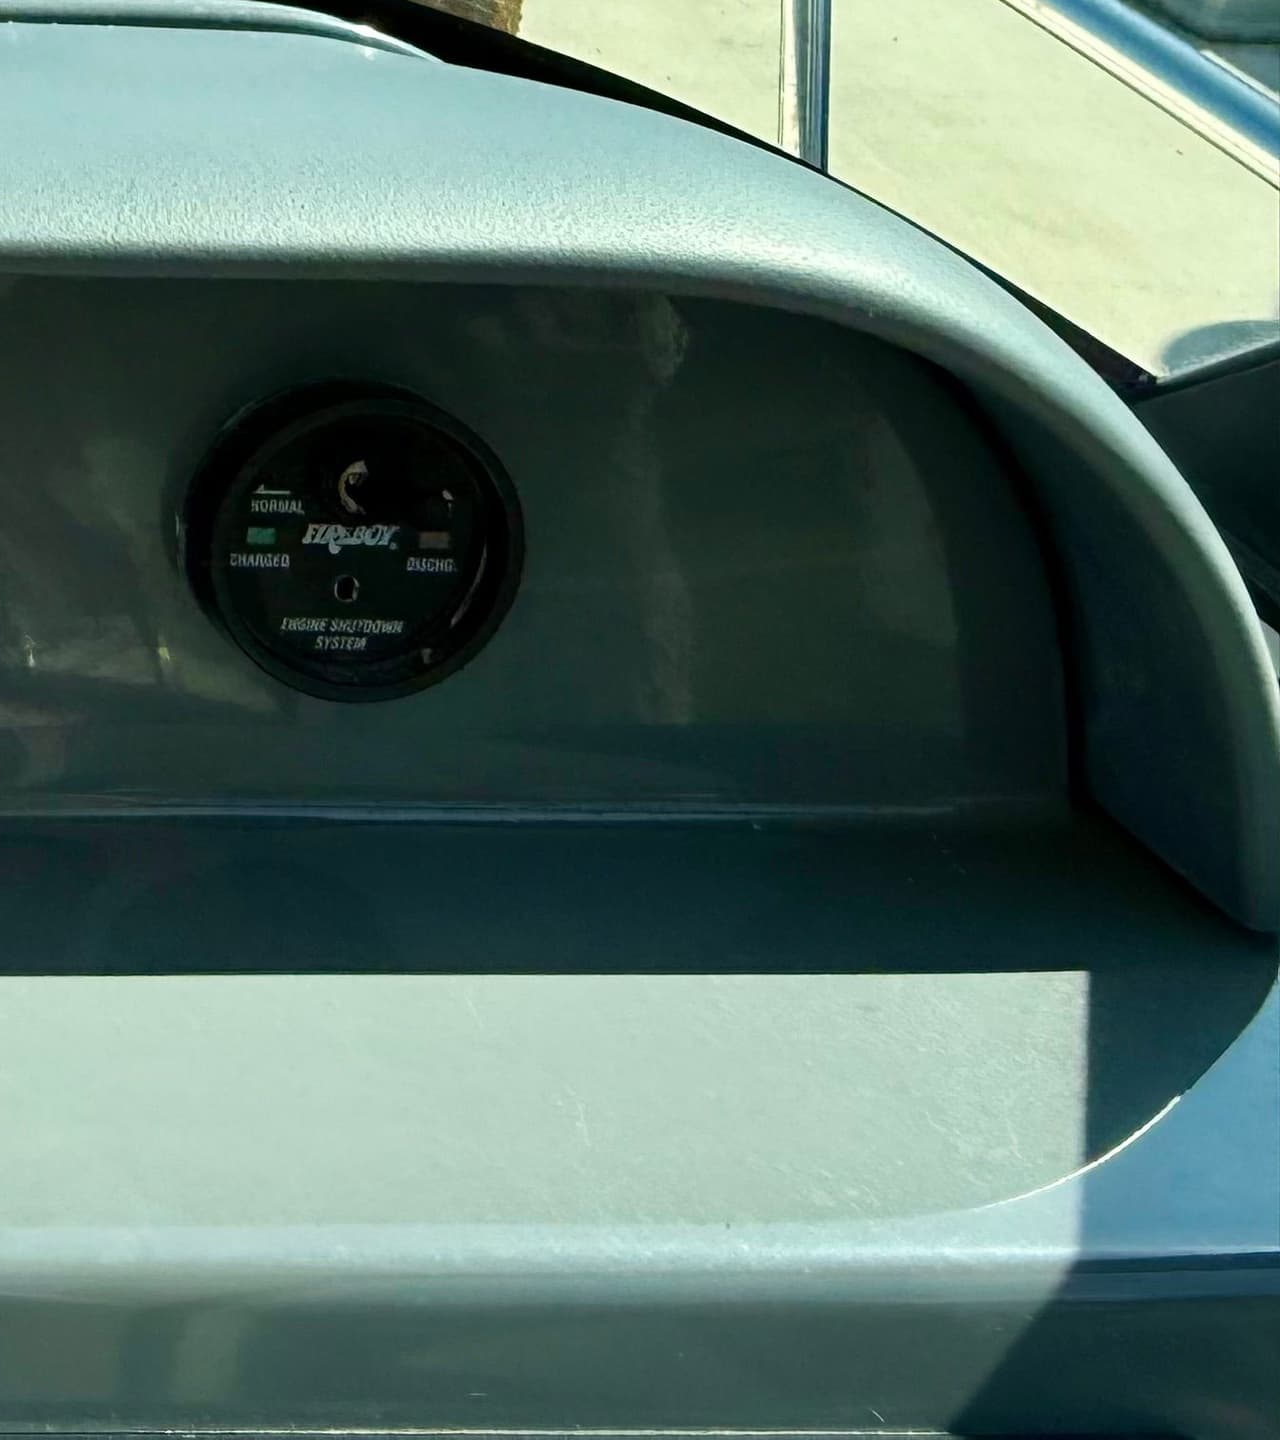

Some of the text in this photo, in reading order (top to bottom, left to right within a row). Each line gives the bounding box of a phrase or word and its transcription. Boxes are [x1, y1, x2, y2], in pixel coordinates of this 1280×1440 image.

[251, 499, 306, 515] NORMAL
[230, 552, 291, 569] CHARGED
[280, 617, 406, 634] ENGINE SHUTDOWN
[315, 635, 368, 651] SYSTEM
